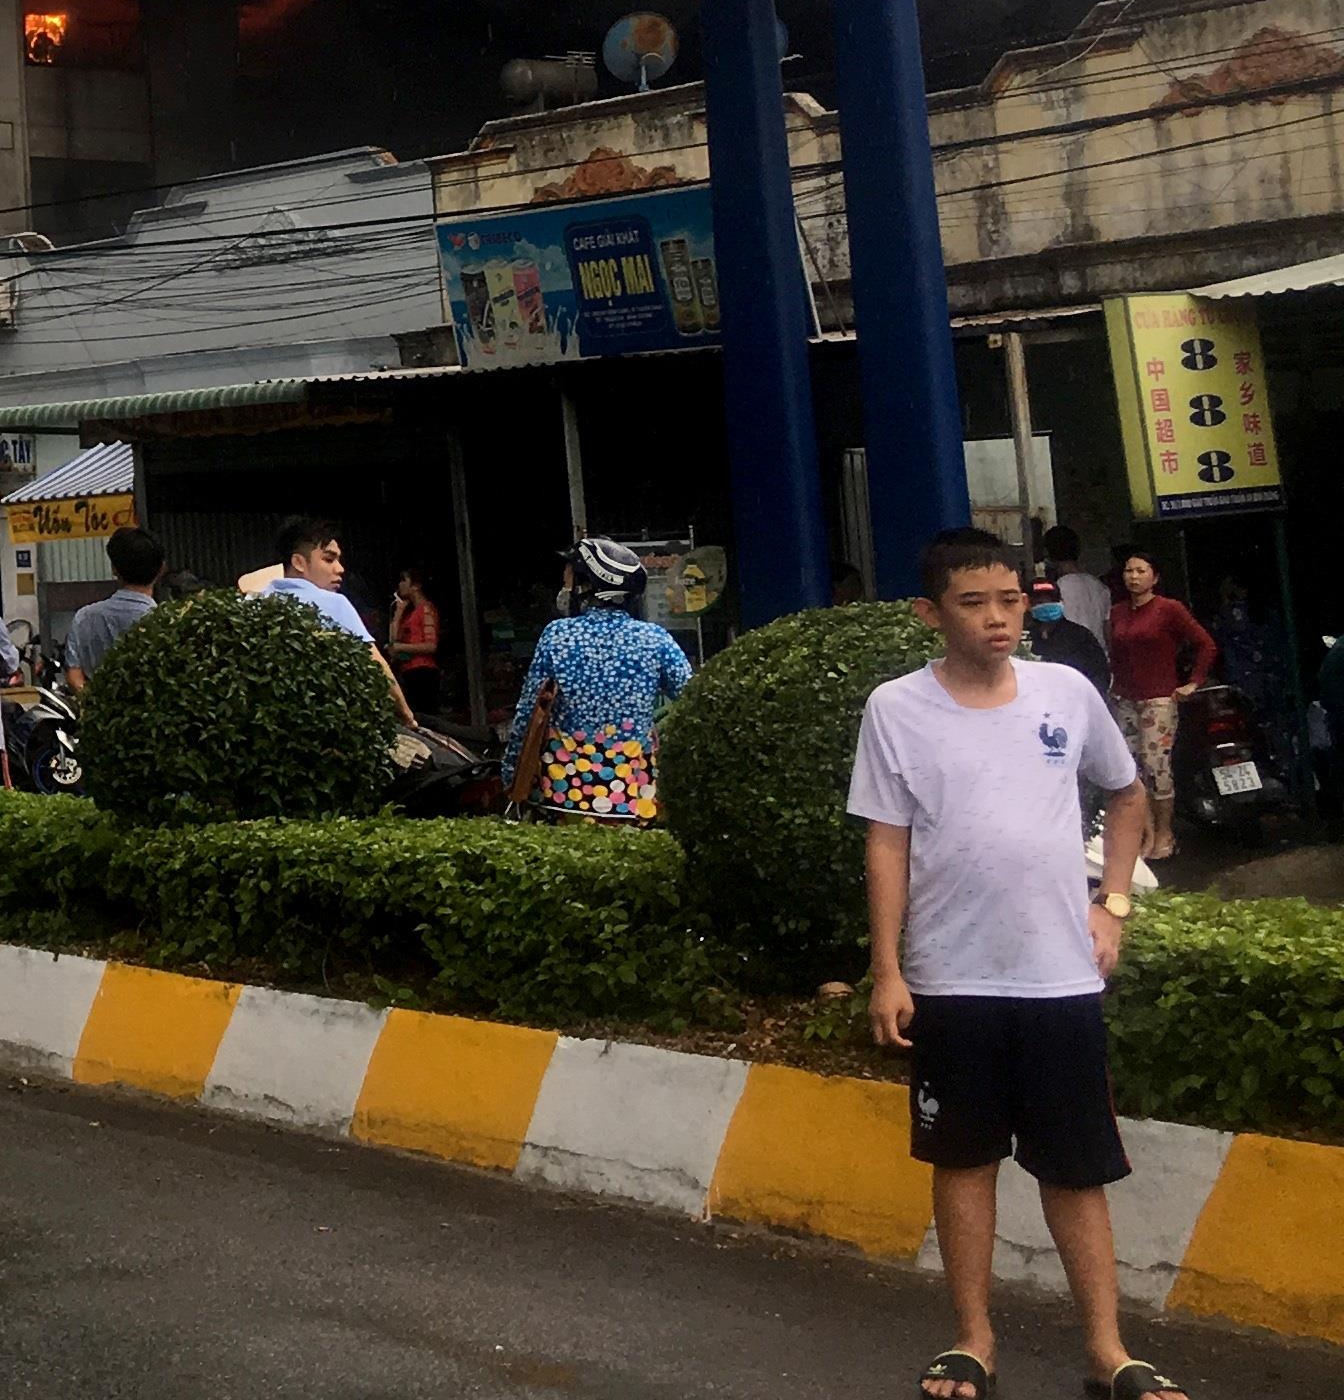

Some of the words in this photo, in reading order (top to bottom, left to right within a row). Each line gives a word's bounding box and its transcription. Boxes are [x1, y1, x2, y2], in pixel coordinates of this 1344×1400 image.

[620, 254, 655, 295] MAI
[1146, 356, 1180, 475] 中国超市
[1233, 350, 1268, 467] 家乡味道
